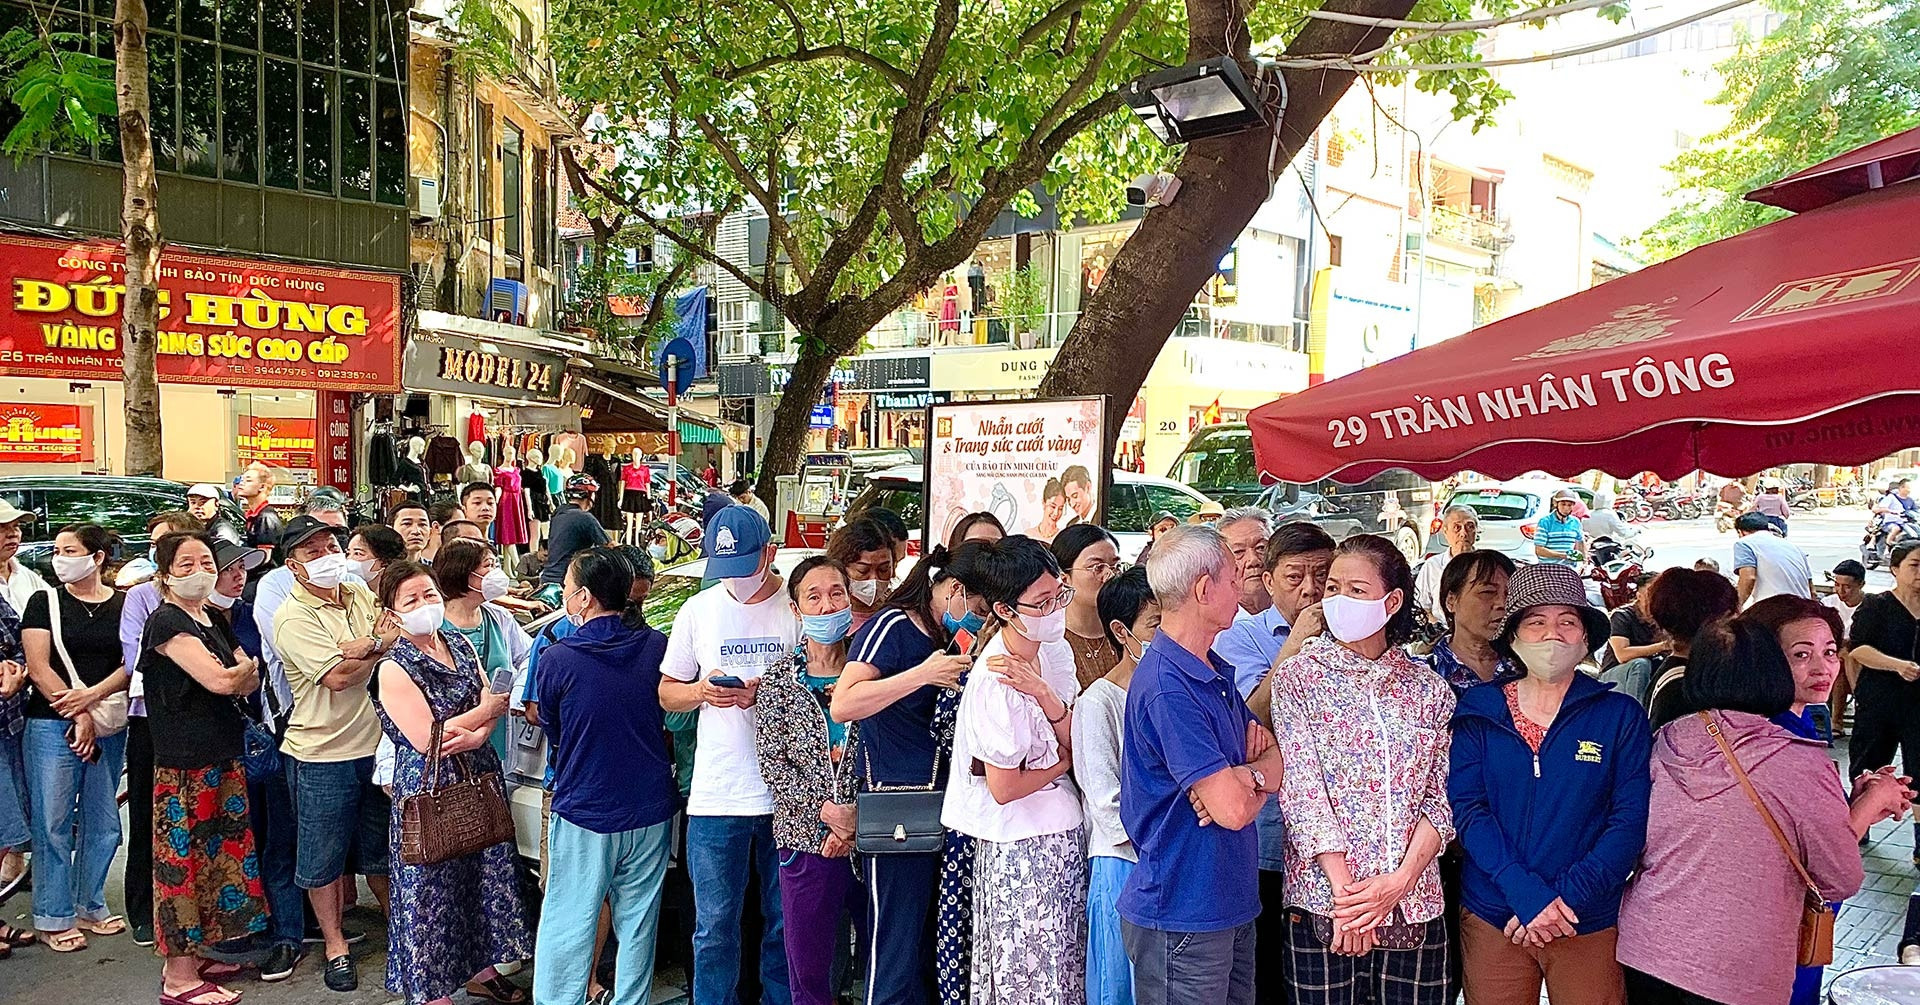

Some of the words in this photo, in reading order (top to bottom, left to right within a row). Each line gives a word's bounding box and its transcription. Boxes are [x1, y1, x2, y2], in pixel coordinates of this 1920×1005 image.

[57, 255, 107, 271] CÔNG
[184, 266, 216, 281] BẢO
[219, 271, 243, 284] TÍN
[285, 278, 325, 292] HÙNG
[185, 287, 370, 336] HÙNG
[40, 319, 117, 351] VÀNG
[257, 337, 303, 362] CAO
[307, 335, 350, 364] CẤP
[0, 351, 24, 362] 26
[67, 355, 103, 367] NHÂN
[1001, 360, 1037, 372] DUNG
[227, 365, 251, 374] TEL:
[442, 347, 523, 388] MODEL
[527, 361, 552, 392] 24
[333, 399, 346, 414] GIA
[1327, 418, 1369, 449] 29
[1370, 393, 1473, 441] TRẦN
[1480, 373, 1599, 423] NHÂN
[1601, 352, 1736, 402] TÔNG
[329, 420, 349, 437] CÔNG
[977, 416, 1013, 437] Nhẫn
[1016, 417, 1045, 436] cưới
[1159, 420, 1177, 431] 20
[333, 440, 348, 460] CHẾ
[943, 441, 951, 454] &
[955, 437, 989, 456] Trang
[991, 436, 1014, 452] sức
[1016, 435, 1045, 452] cưới
[1047, 434, 1083, 455] vàng
[334, 465, 347, 483] TÁC
[965, 460, 981, 471] CỦA
[982, 460, 998, 471] BẢO
[999, 460, 1012, 471] TÍN
[1013, 462, 1034, 471] MINH
[1035, 460, 1059, 471] CHÂU
[720, 642, 785, 656] EVOLUTION
